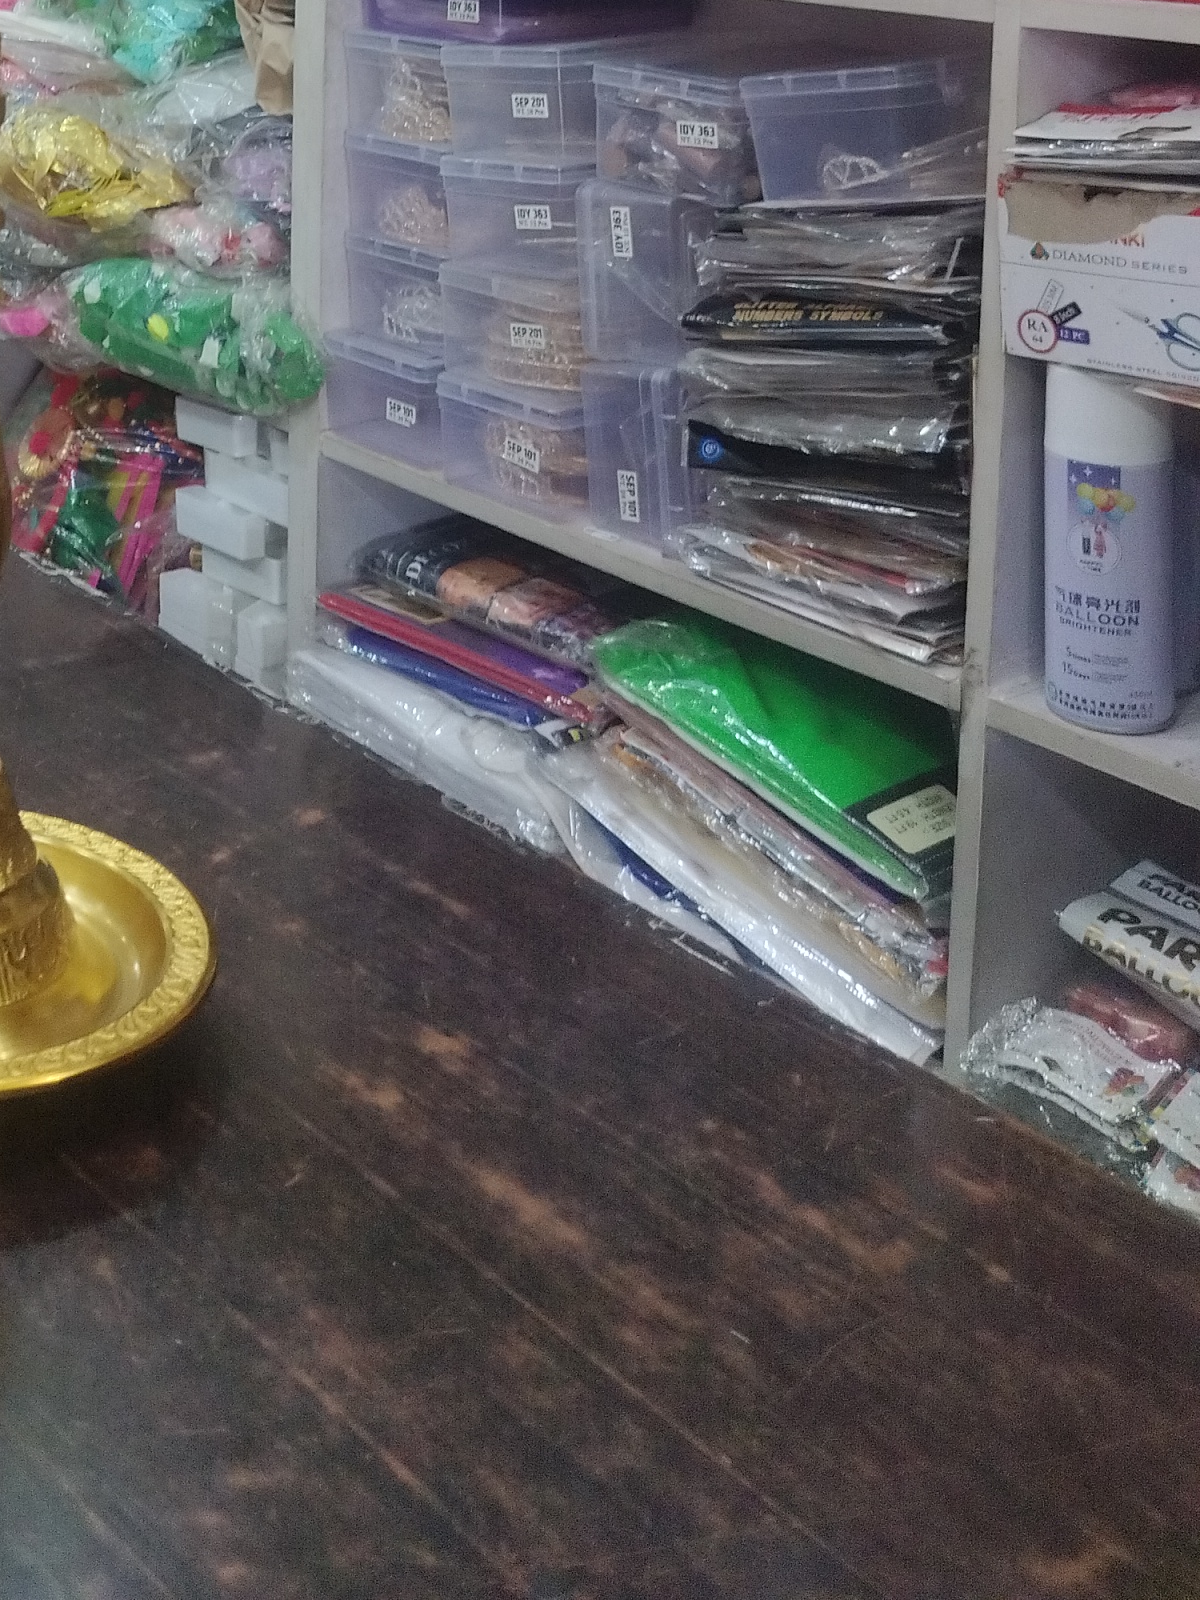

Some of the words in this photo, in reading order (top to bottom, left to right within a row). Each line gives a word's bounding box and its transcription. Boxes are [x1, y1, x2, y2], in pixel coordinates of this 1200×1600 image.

[1052, 249, 1128, 269] DIAMOND
[1131, 261, 1189, 275] SERIES
[809, 309, 883, 321] SYMBOLS
[507, 440, 522, 454] SEP
[524, 447, 538, 462] 101
[626, 474, 636, 497] SEP
[628, 500, 637, 518] 101
[1055, 601, 1141, 627] BALLOON
[1058, 614, 1133, 637] BRIGHTENER
